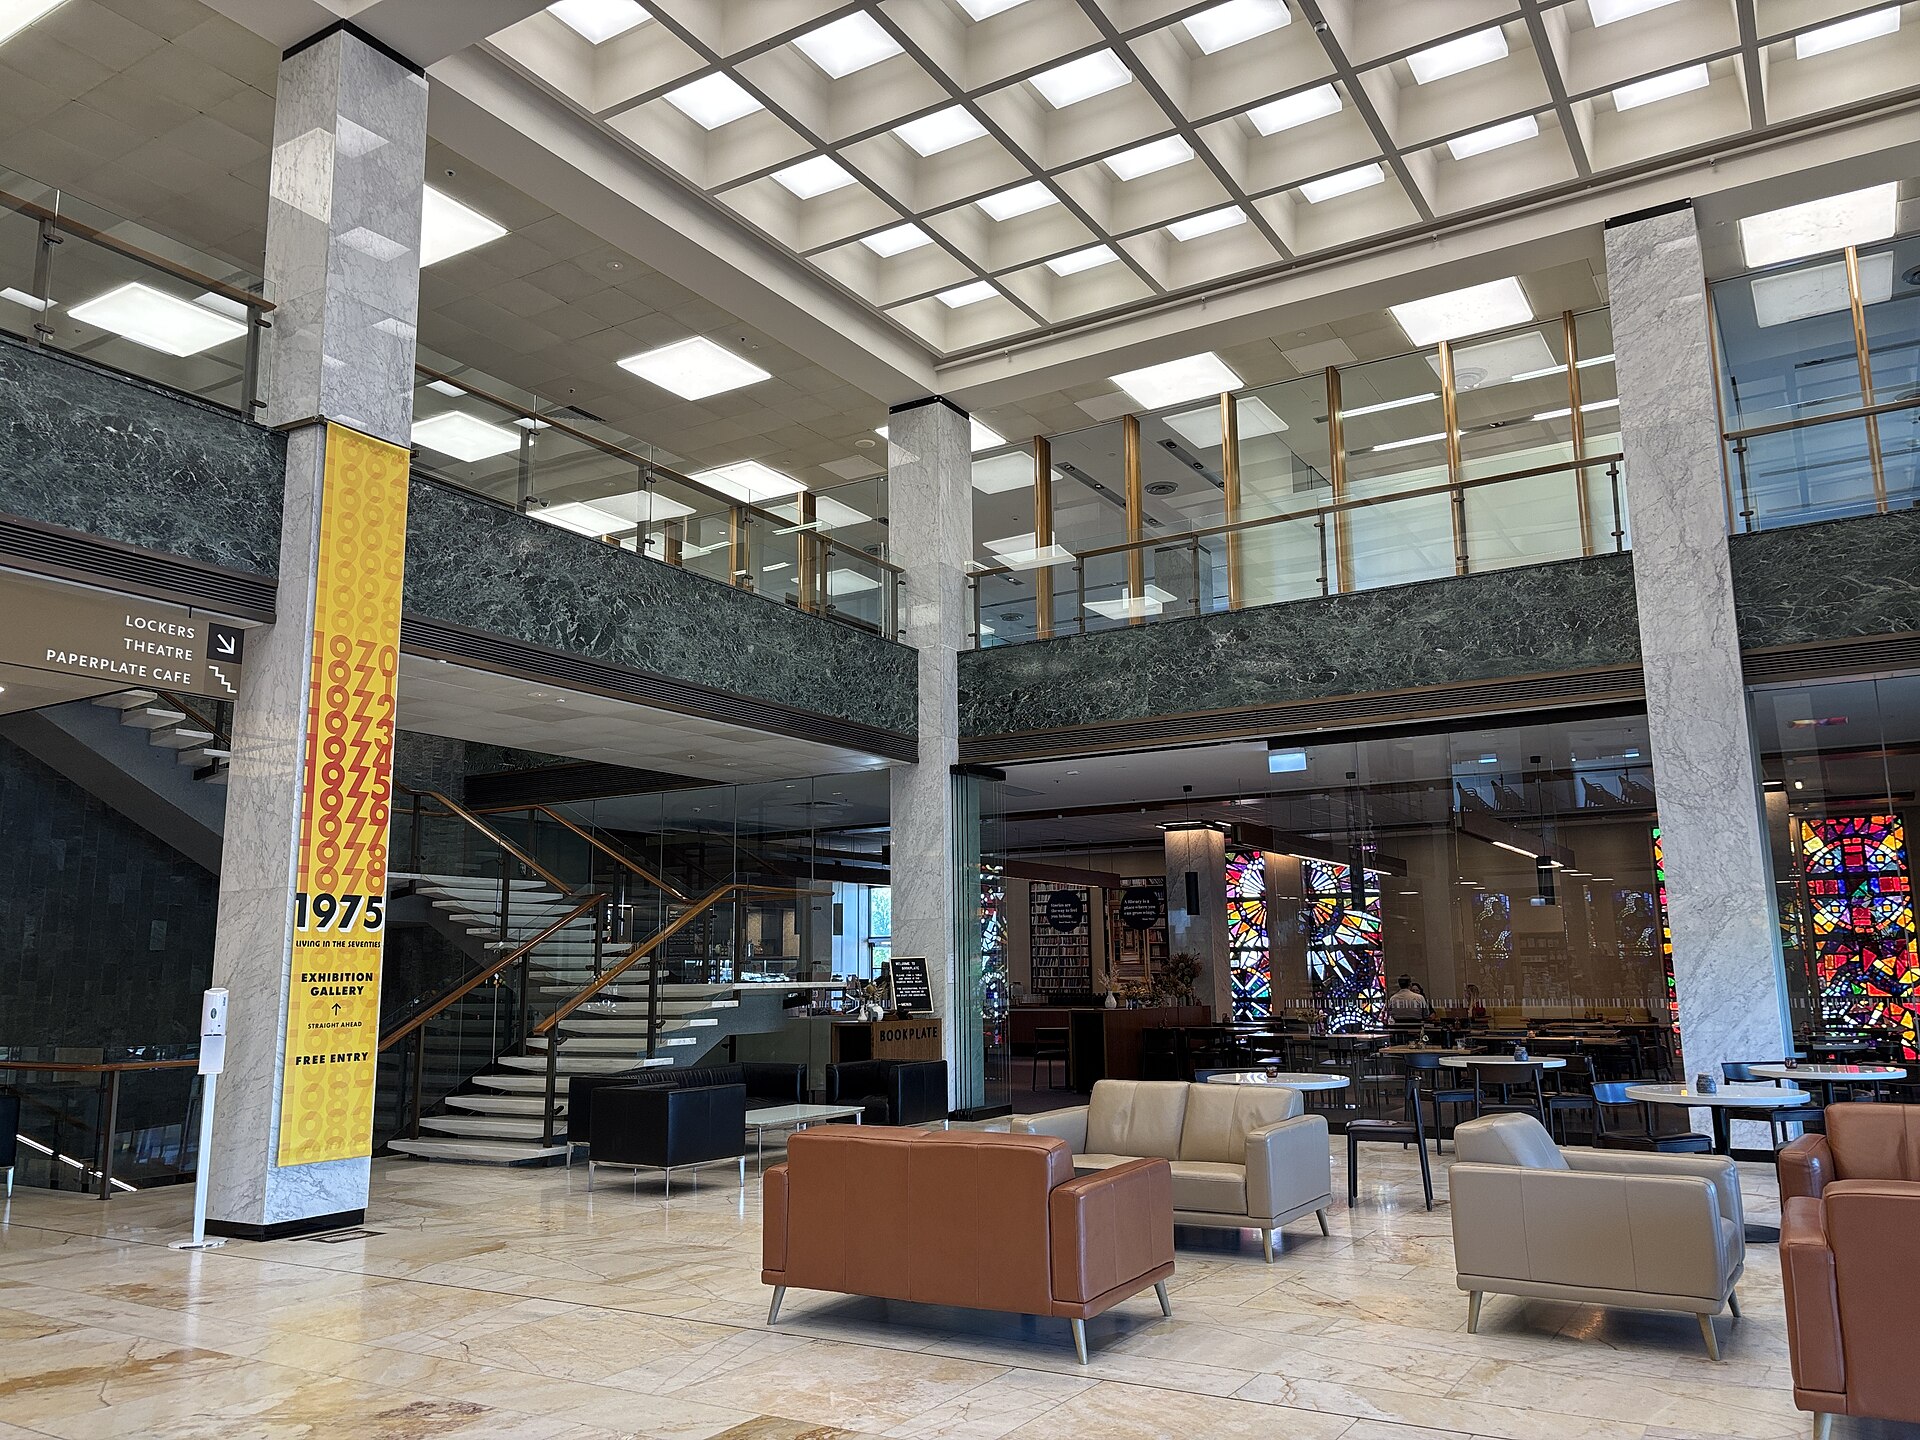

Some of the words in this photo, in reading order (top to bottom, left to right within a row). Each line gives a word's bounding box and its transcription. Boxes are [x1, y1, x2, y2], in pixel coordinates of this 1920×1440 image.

[126, 615, 195, 639] LOCKERS
[124, 638, 193, 661] THEATRE
[314, 630, 398, 678] 1970
[47, 649, 147, 677] PAPERPLATE
[153, 668, 191, 684] CAFE
[296, 892, 383, 931] 1975
[348, 940, 380, 948] SEVENTIES
[301, 972, 373, 982] EXHIBITION
[310, 986, 364, 996] GALLERY
[880, 1026, 938, 1041] BOOKPLATE
[295, 1055, 325, 1065] FREE
[330, 1052, 368, 1063] ENTRY
